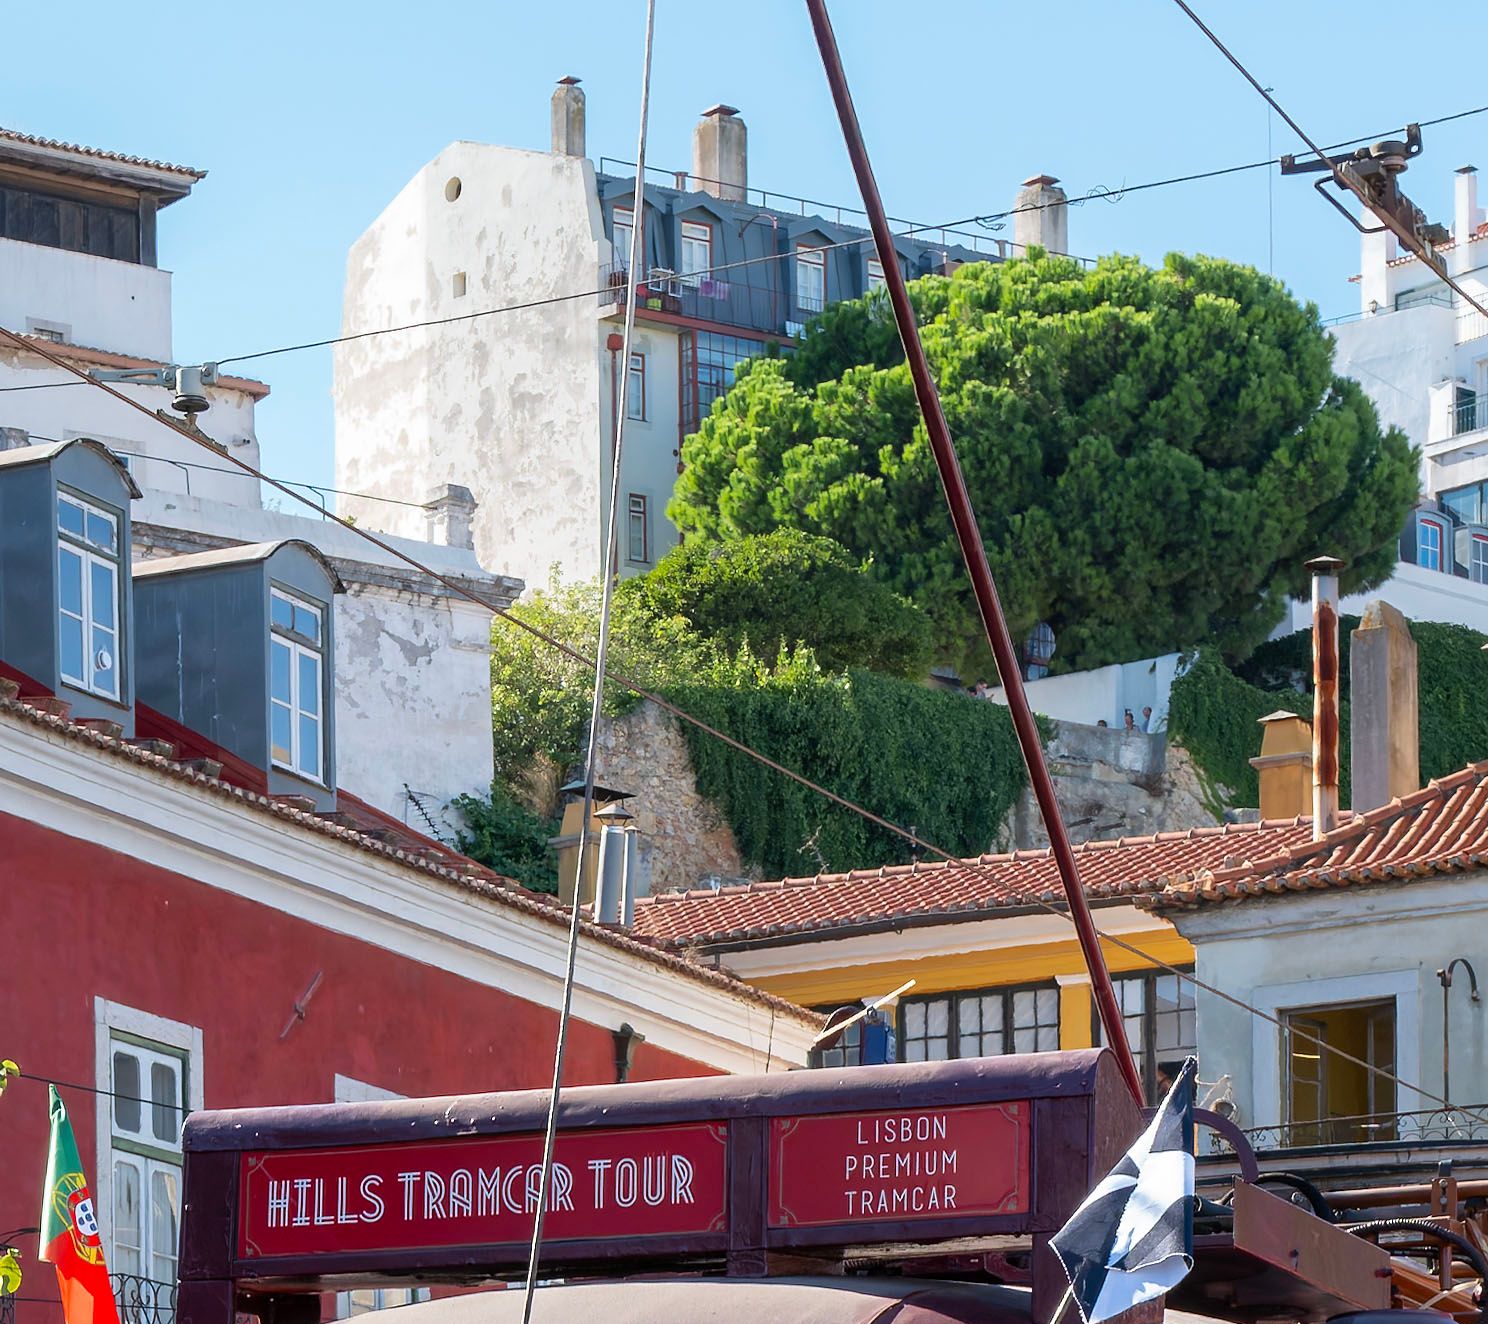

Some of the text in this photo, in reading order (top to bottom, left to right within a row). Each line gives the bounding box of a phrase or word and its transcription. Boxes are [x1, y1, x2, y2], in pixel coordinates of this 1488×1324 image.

[857, 1115, 947, 1144] LISBON
[845, 1150, 958, 1180] PREMIUM
[267, 1154, 695, 1227] HILLS TRAMCAR TOUR
[844, 1185, 957, 1216] TRAMCAR
